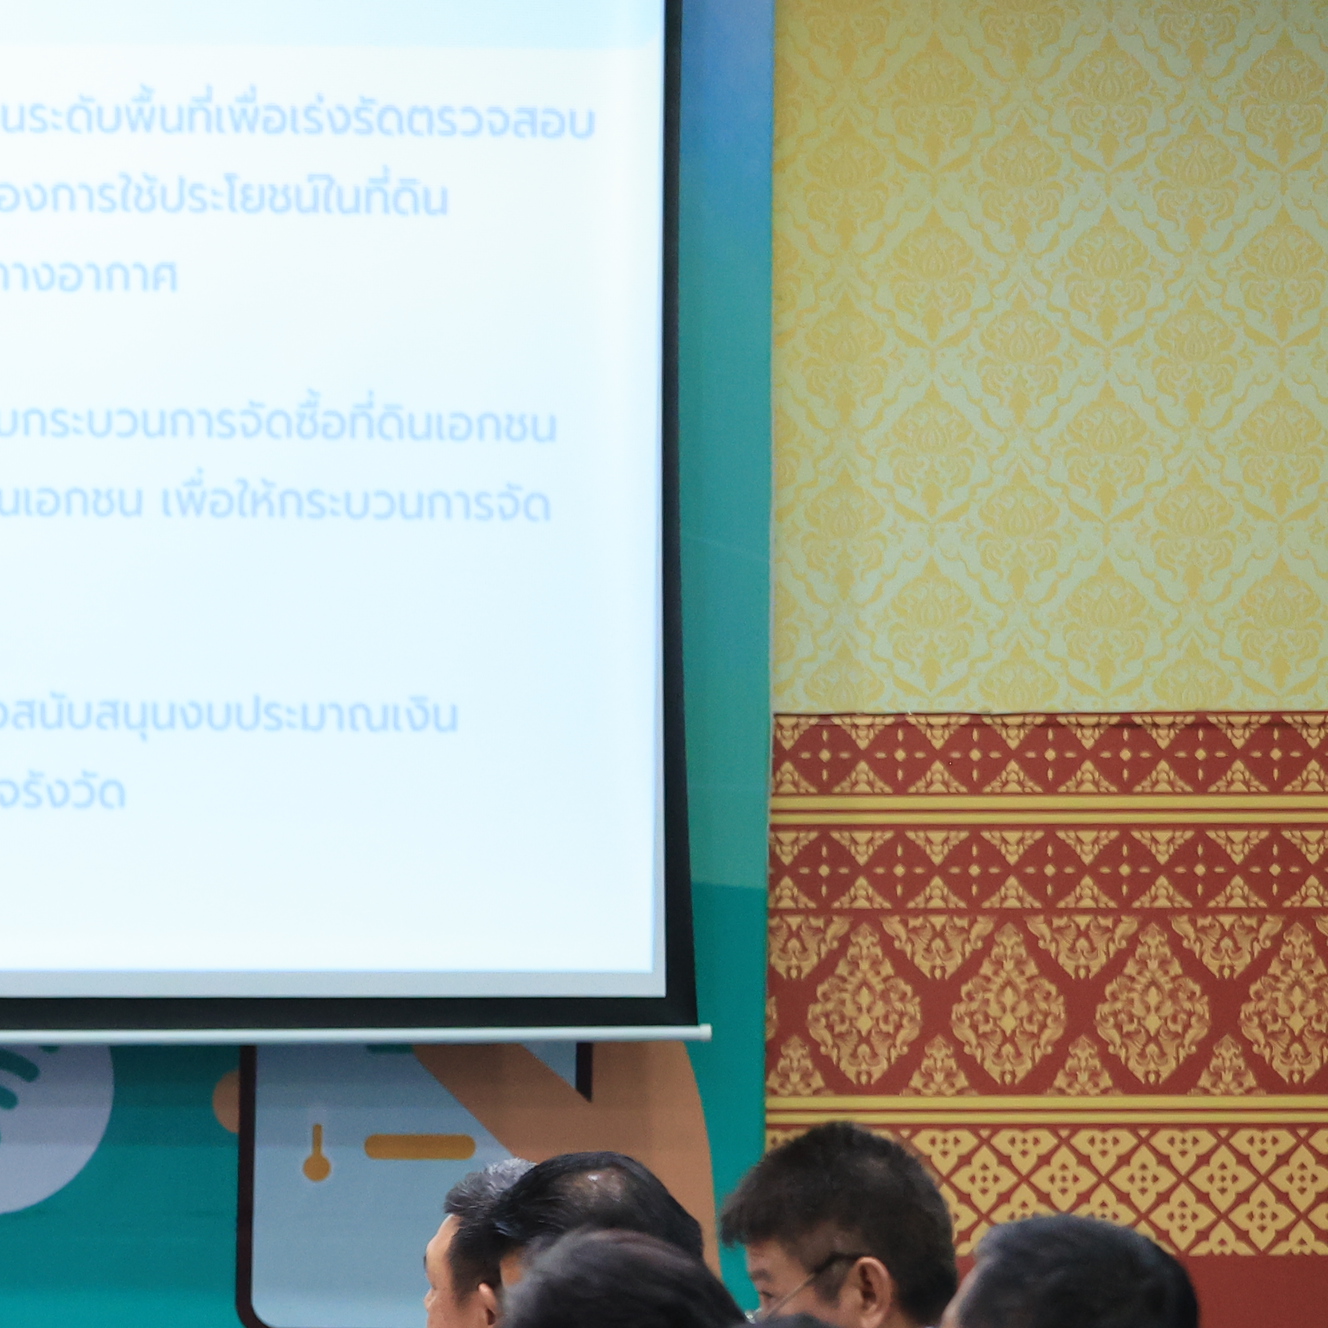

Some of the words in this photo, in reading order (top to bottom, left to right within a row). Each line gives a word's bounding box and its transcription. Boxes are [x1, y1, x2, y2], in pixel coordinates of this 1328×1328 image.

[160, 466, 552, 524] เพื่อให้กระบวนการจัด
